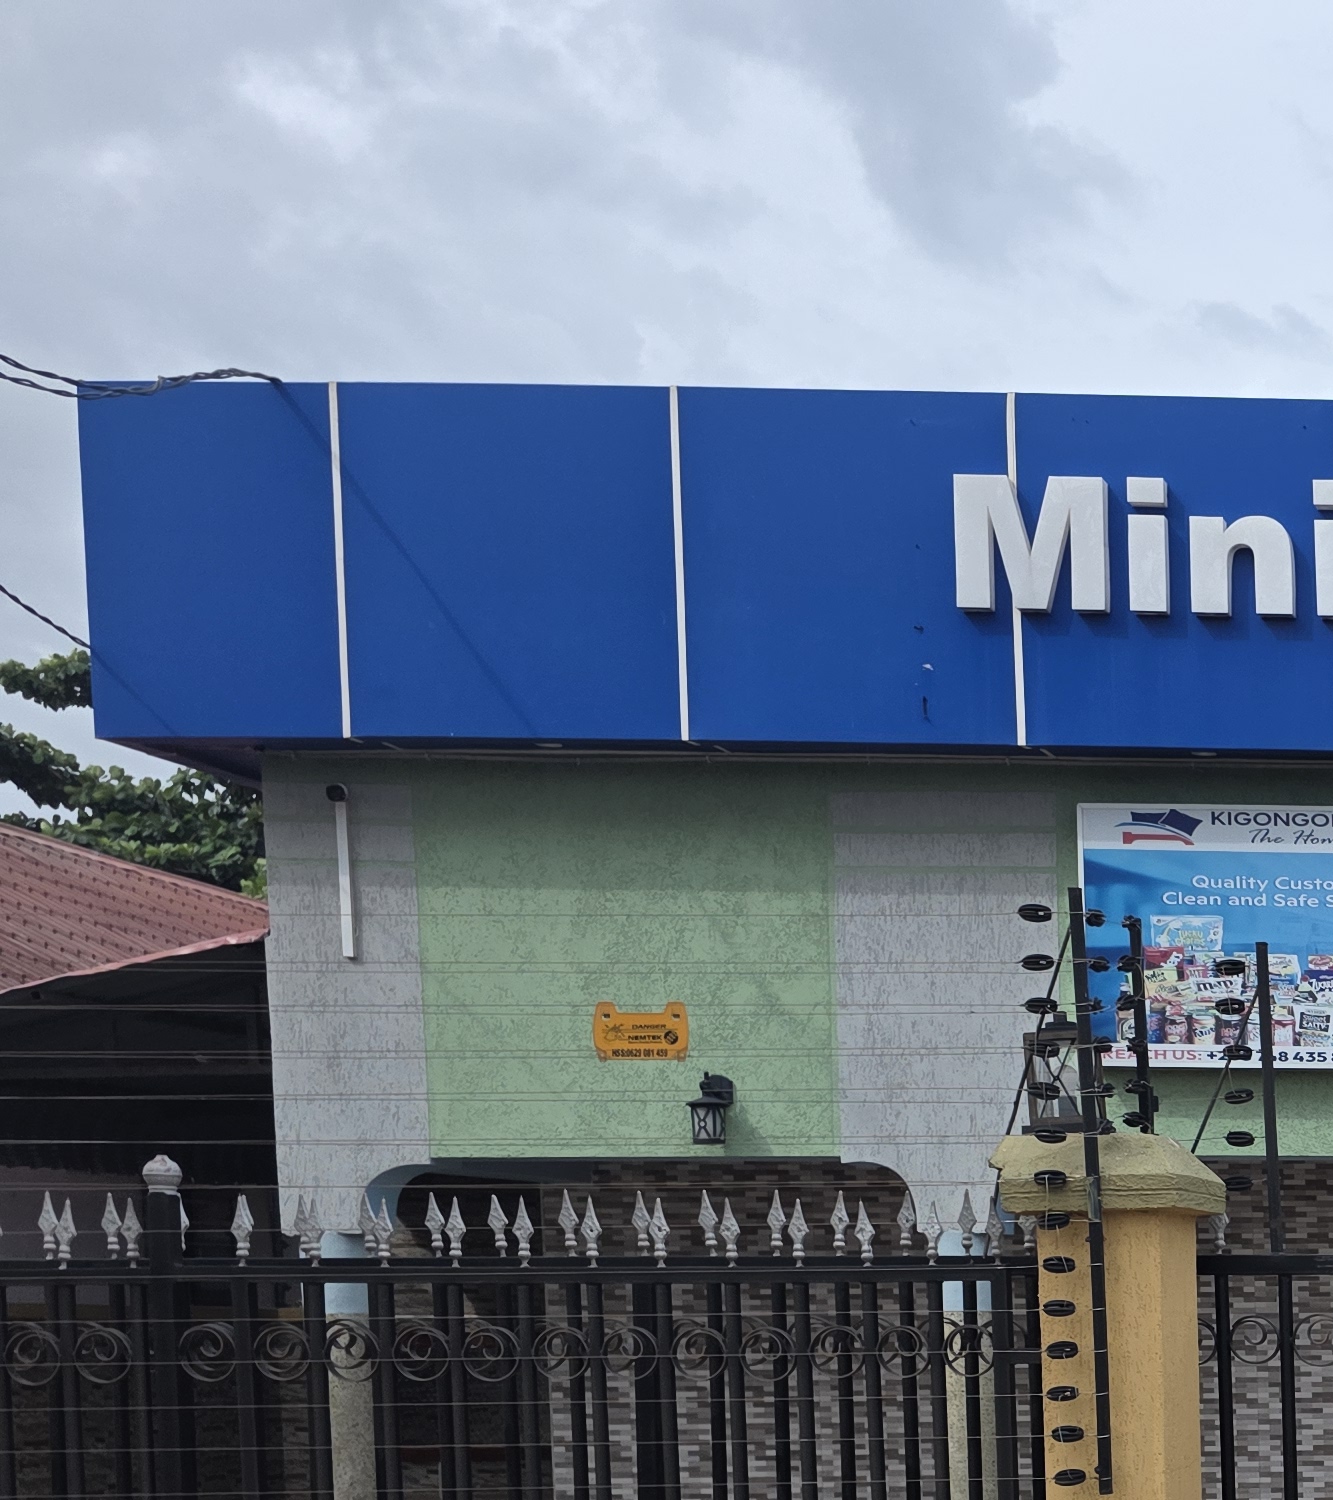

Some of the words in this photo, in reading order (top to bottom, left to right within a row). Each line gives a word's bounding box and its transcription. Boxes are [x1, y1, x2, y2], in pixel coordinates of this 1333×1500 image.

[1249, 828, 1285, 845] The
[1192, 875, 1269, 892] Quality
[1162, 891, 1223, 906] Clean
[1228, 892, 1267, 907] and
[1272, 893, 1320, 908] Safe
[1172, 1050, 1202, 1061] US:
[1292, 1051, 1328, 1063] 435
